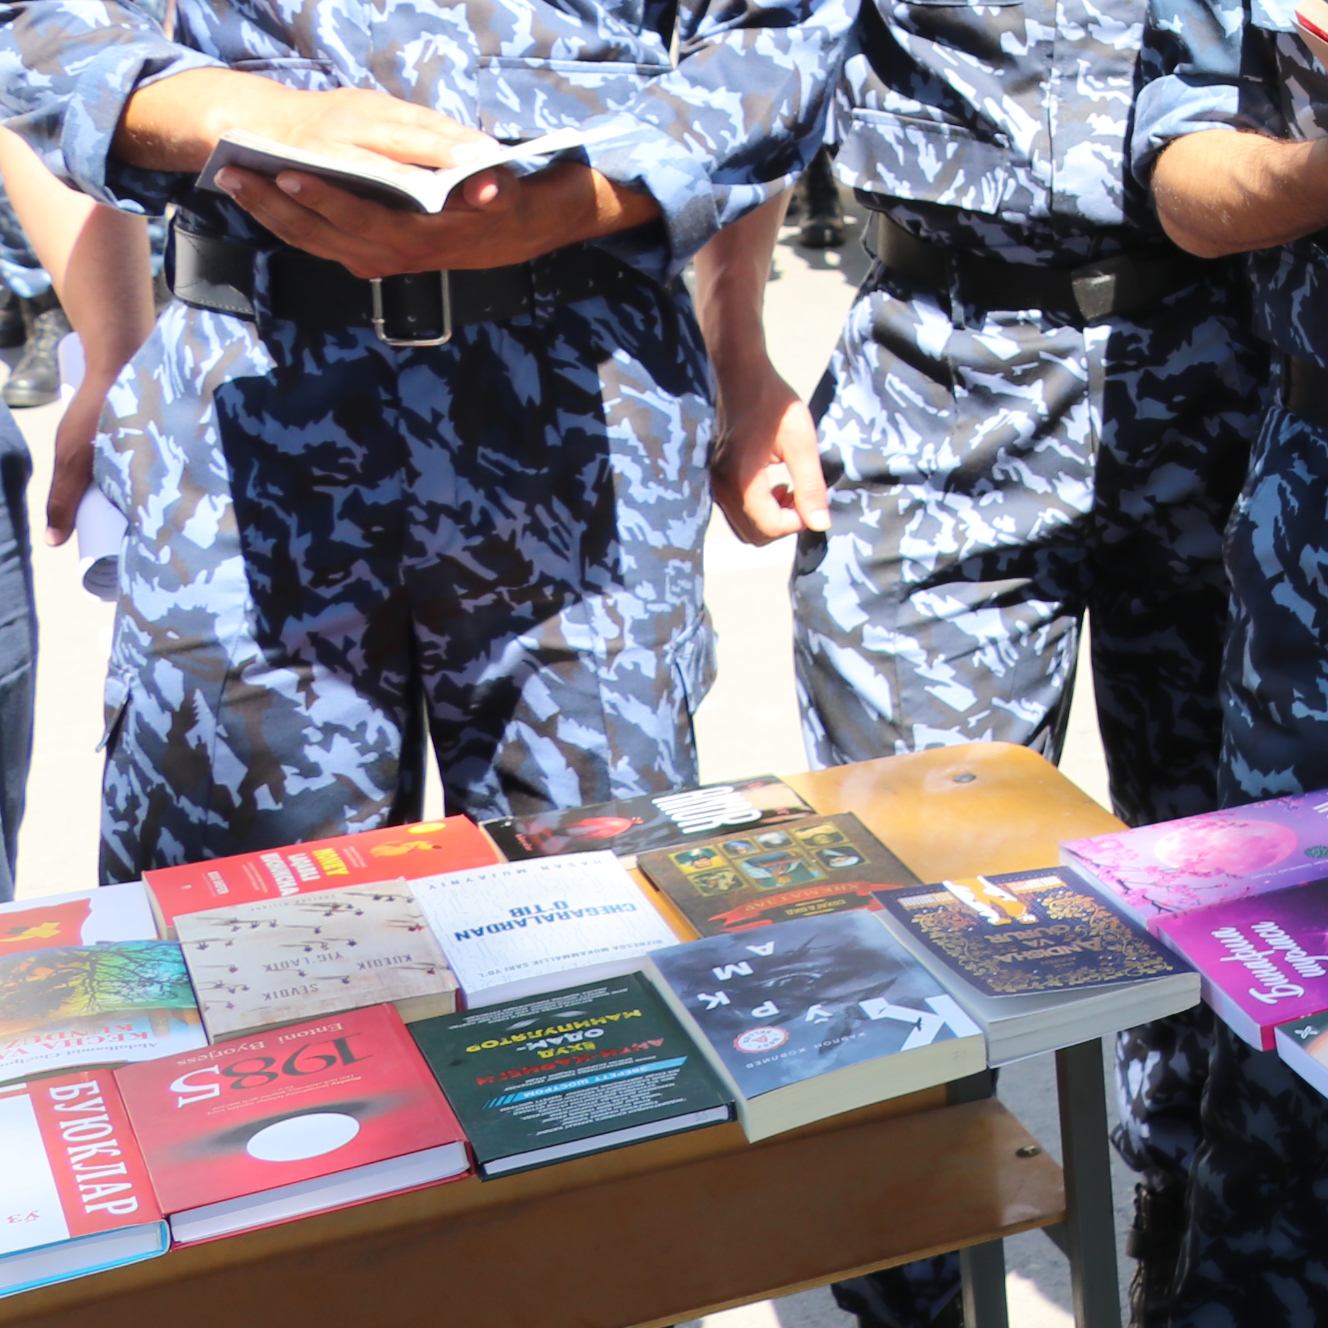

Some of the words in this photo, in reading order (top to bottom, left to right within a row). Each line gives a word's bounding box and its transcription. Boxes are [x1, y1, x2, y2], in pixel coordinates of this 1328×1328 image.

[452, 902, 635, 940] CHEGARALARDAN
[278, 1020, 343, 1042] Entoni
[464, 1008, 641, 1053] МАНИПУЛЯТОР
[168, 1032, 372, 1108] 1985
[176, 1038, 264, 1066] Byorjess
[49, 1080, 138, 1214] БУЮКЛАР
